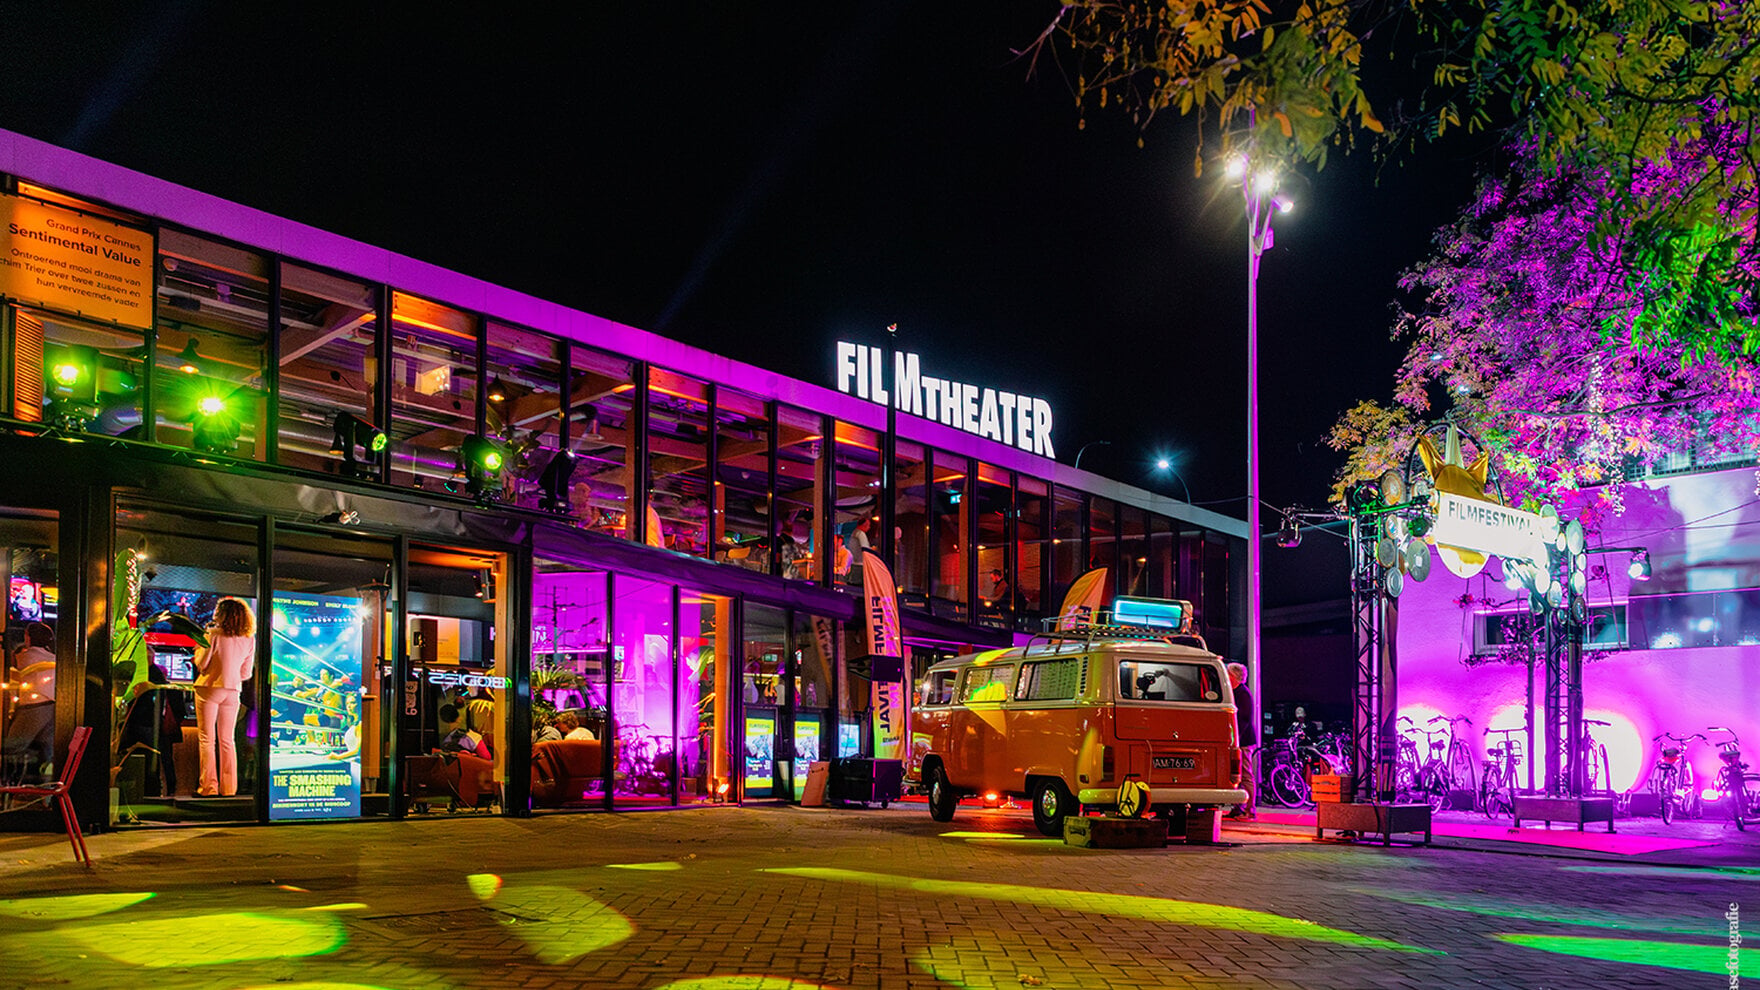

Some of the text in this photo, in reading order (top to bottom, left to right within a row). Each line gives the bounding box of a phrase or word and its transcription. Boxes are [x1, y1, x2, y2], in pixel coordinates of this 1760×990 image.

[9, 222, 141, 267] Sentimental Value
[46, 218, 141, 251] Grand Prix Cannes
[11, 247, 141, 287] Ontroerend mooi drama van
[24, 262, 45, 274] Trier
[48, 270, 69, 280] over
[71, 274, 94, 286] twee
[96, 281, 127, 294] zussen
[129, 289, 141, 298] en
[36, 277, 139, 308] hun vervreemde vader
[837, 341, 1056, 459] FILMTHEATER
[273, 774, 352, 786] THE SMASHING
[288, 785, 336, 797] MACHINE
